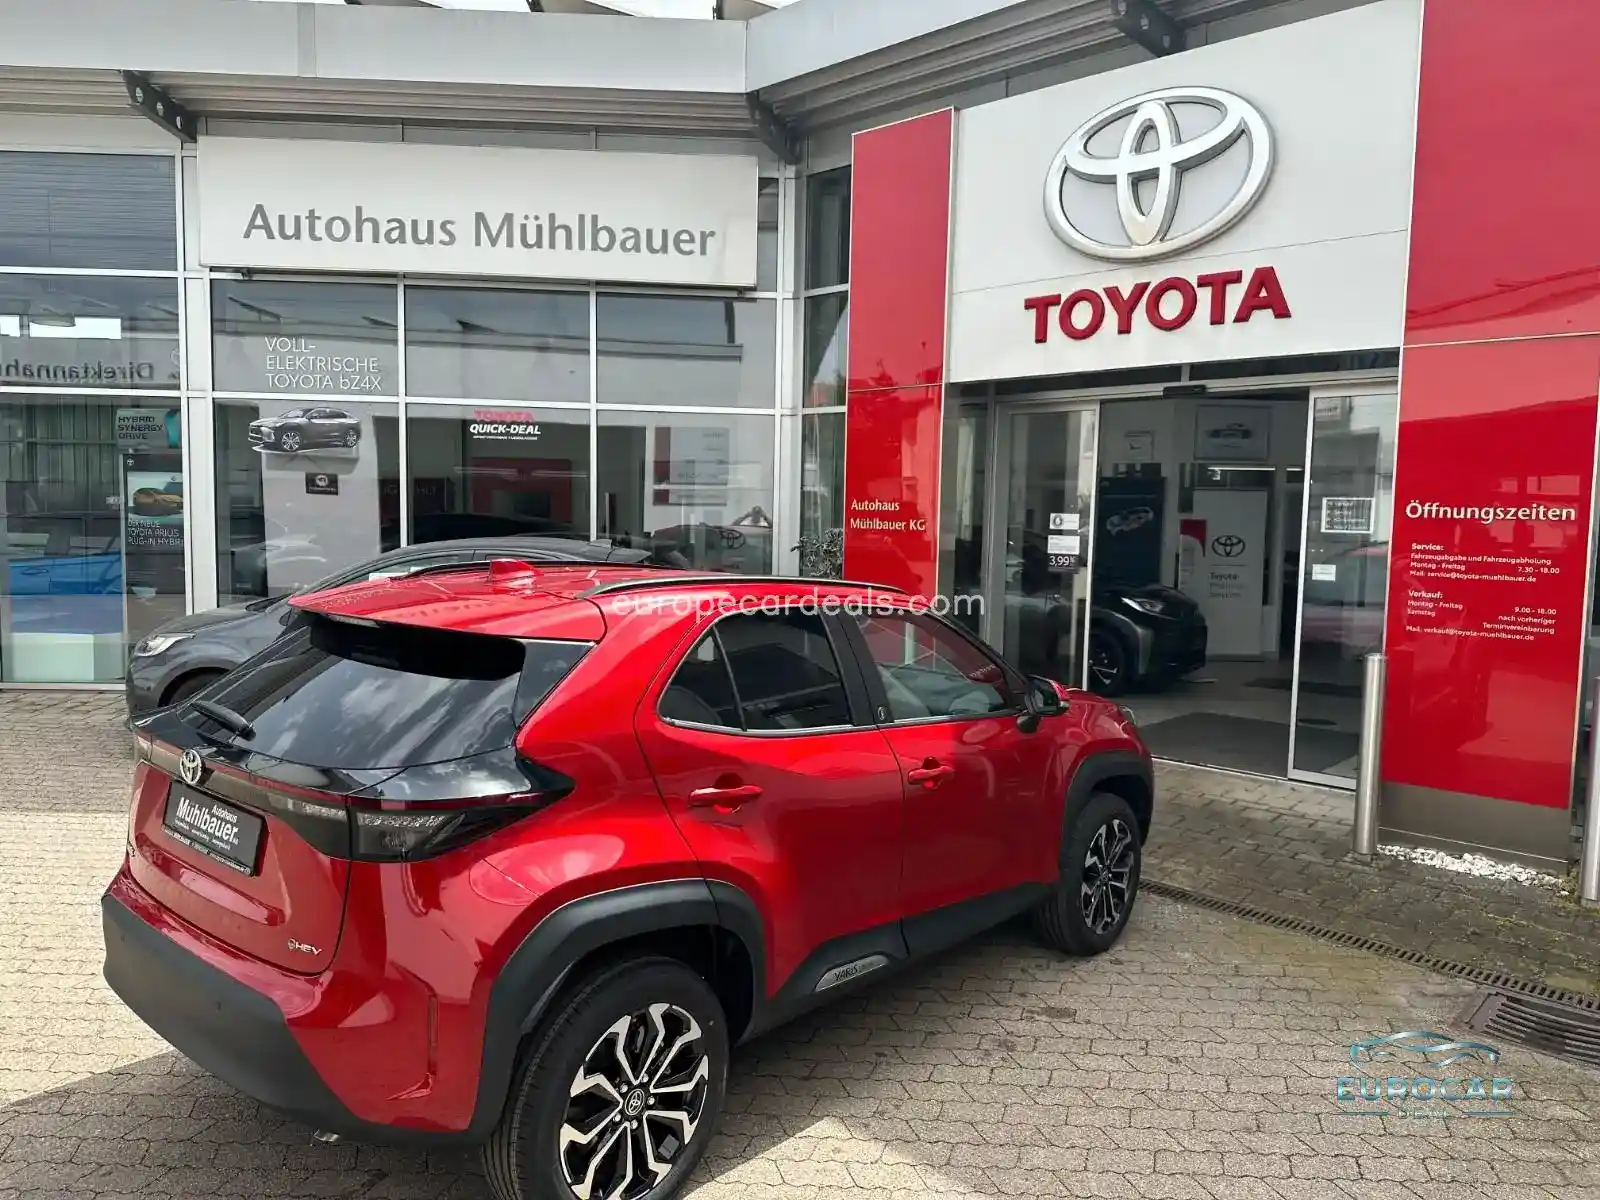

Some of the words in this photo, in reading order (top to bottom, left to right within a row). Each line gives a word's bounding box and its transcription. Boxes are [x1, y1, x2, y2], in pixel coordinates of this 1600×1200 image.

[242, 203, 456, 246] Autohaus
[474, 211, 716, 256] Mühlbauer
[1024, 266, 1292, 343] TOYOTA
[265, 336, 316, 352] VOLL-
[266, 355, 379, 372] ELEKTRISCHE
[266, 373, 333, 389] TOYOTA
[339, 374, 381, 390] bZ4X
[118, 424, 164, 432] SYNERGY
[469, 423, 541, 435] QUICK-DEAL
[118, 432, 149, 440] DRIVE
[851, 498, 900, 512] Autohaus
[1405, 500, 1576, 523] Öffnungszeiten
[850, 517, 906, 531] Mühlbauer
[909, 519, 927, 531] KG
[128, 527, 153, 536] TOYOTA
[1411, 542, 1444, 551] Service:
[1410, 552, 1467, 562] Fahrzeugabgabe
[1483, 556, 1552, 566] Fahrzeugabholung
[1410, 561, 1437, 570] Montag
[1441, 562, 1466, 571] Freitag
[1408, 589, 1443, 599] Verkauf:
[1407, 599, 1434, 608] Montag
[1439, 601, 1463, 611] Freitag
[1517, 616, 1556, 626] vorheriger
[295, 941, 323, 956] HEV
[834, 963, 859, 981] YARIS
